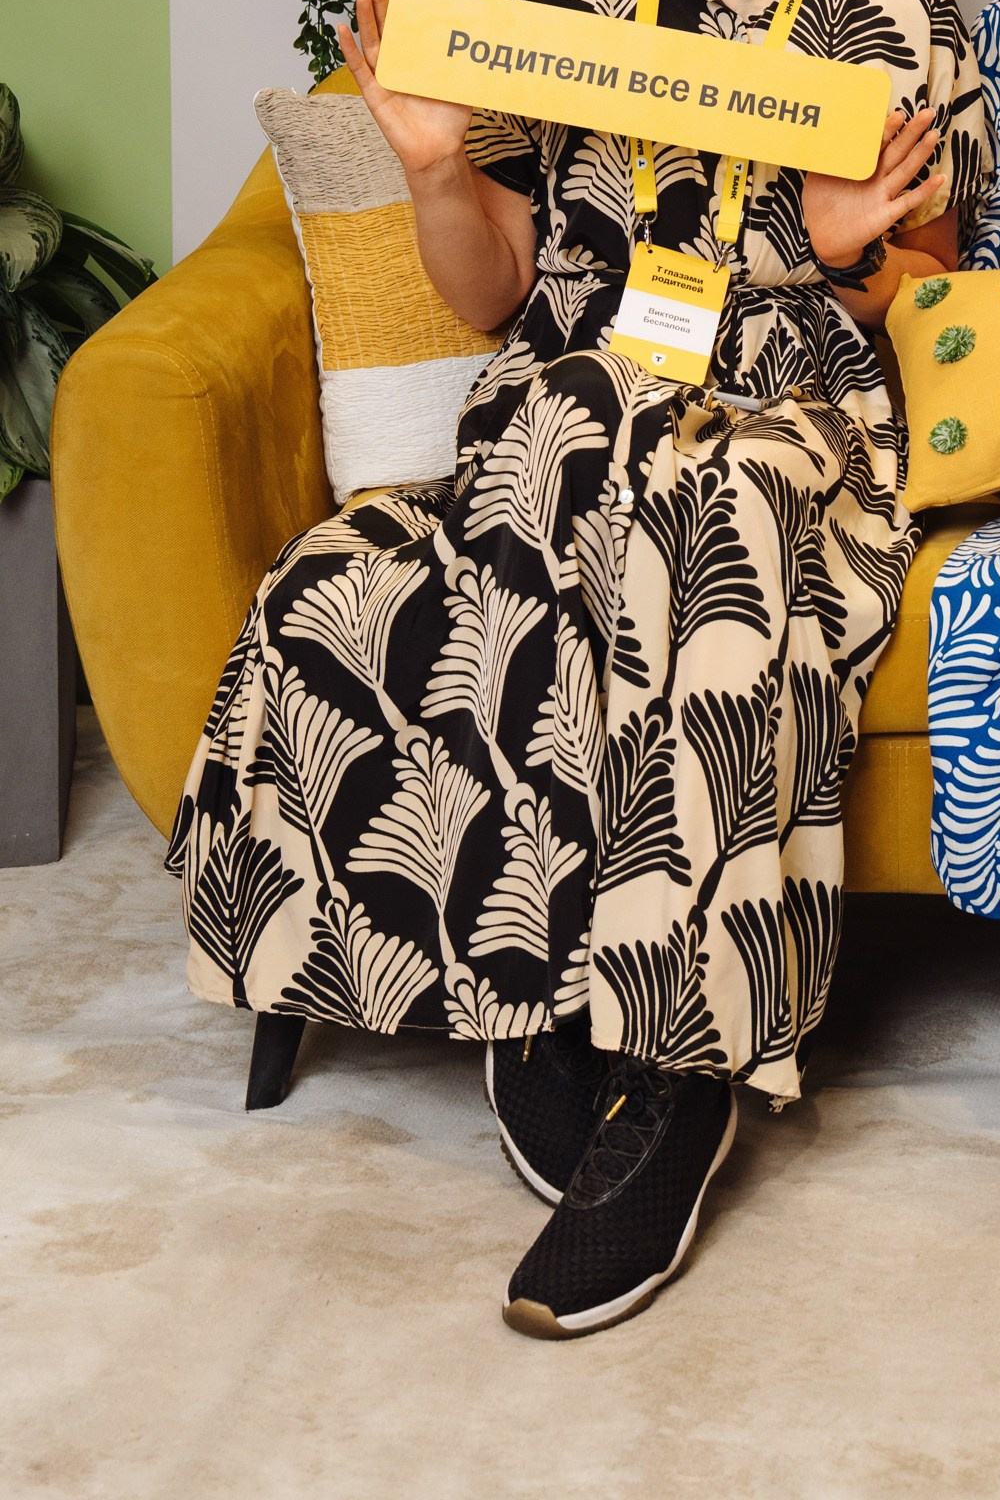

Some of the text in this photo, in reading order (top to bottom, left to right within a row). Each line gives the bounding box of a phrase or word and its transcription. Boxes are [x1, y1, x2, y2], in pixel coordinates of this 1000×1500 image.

[446, 29, 822, 129] Родители все в меня
[636, 137, 645, 156] БАН
[730, 174, 740, 200] БАНК
[651, 274, 704, 294] родителей
[656, 265, 704, 285] Т глазами
[643, 315, 691, 334] Беспалова
[648, 307, 690, 324] Виктория
